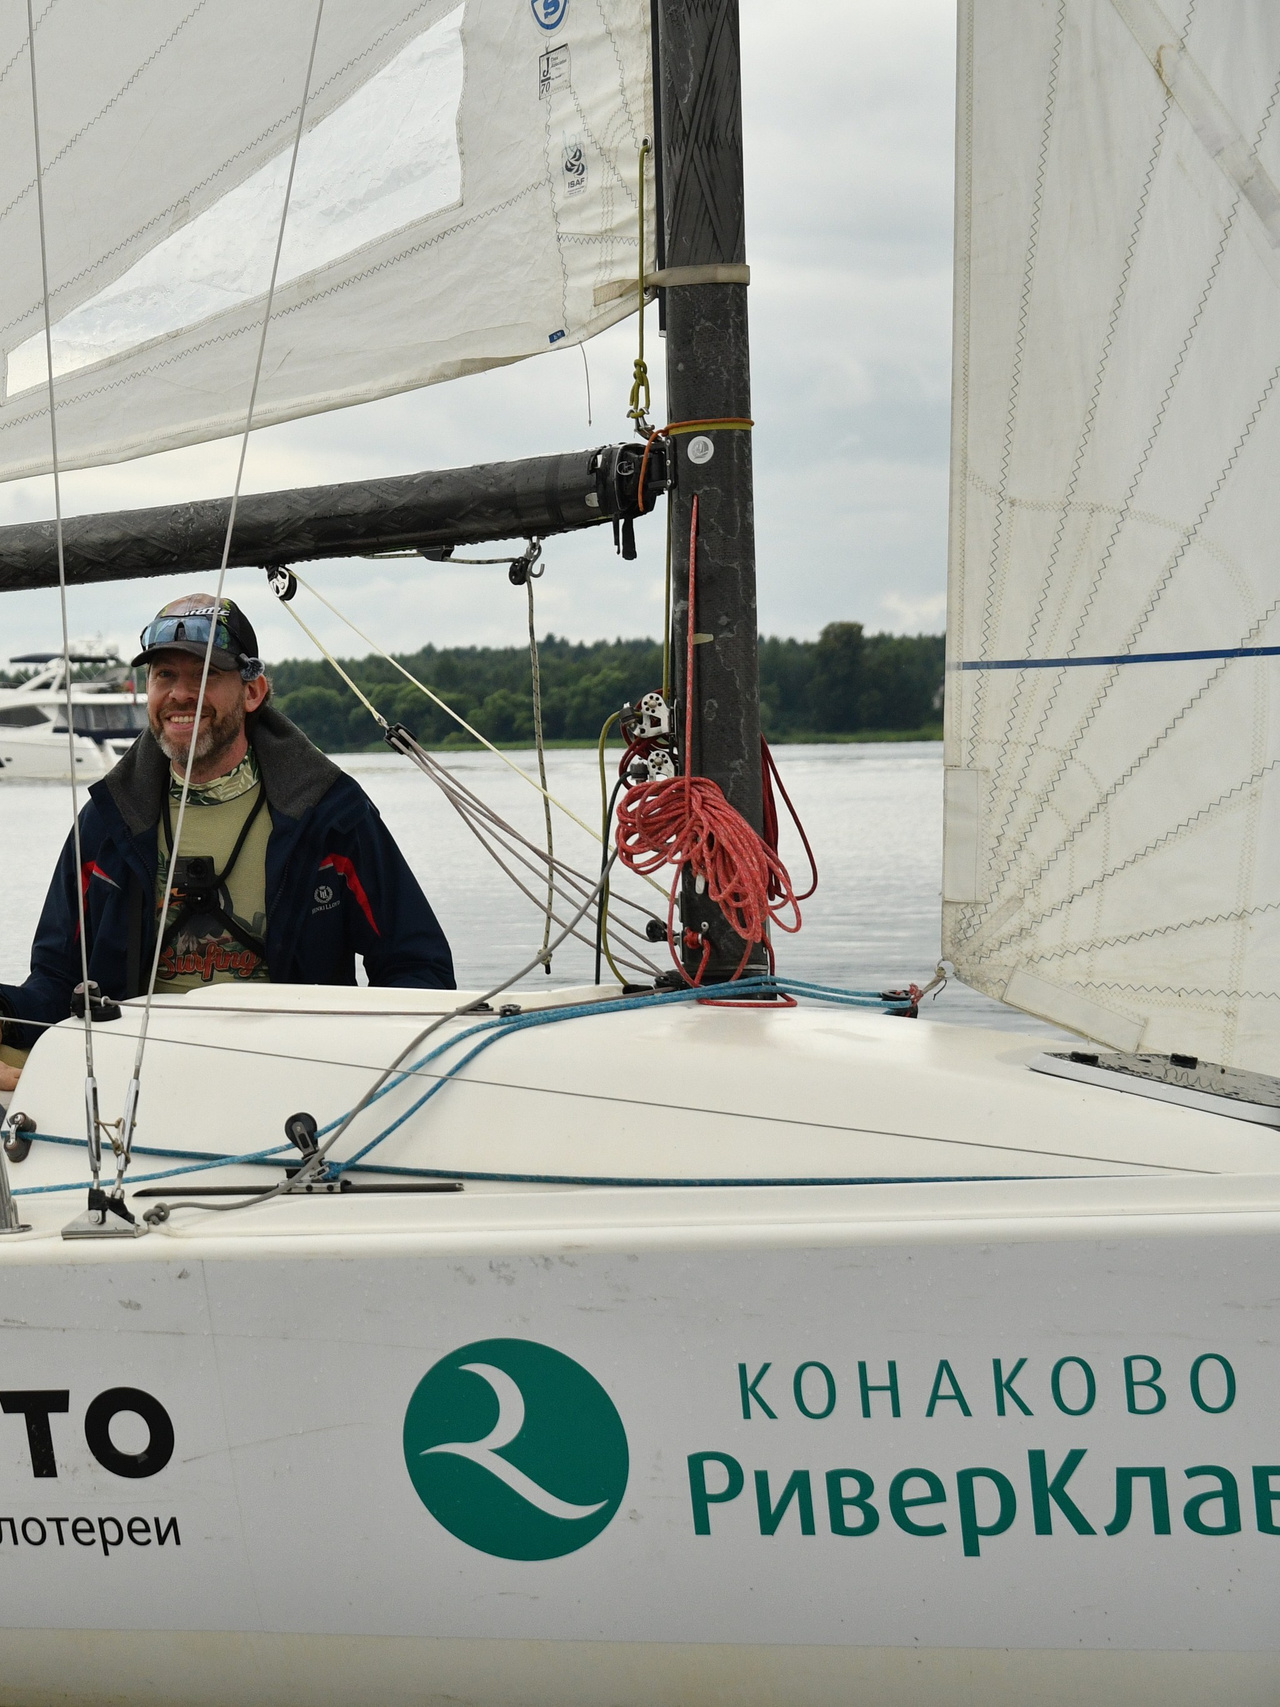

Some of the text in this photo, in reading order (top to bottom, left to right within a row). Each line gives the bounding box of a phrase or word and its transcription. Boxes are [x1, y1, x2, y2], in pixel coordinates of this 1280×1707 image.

[541, 81, 551, 94] 70
[567, 177, 585, 189] ISAF
[157, 942, 261, 981] Surfing
[737, 1352, 1238, 1421] КОНАКОВО
